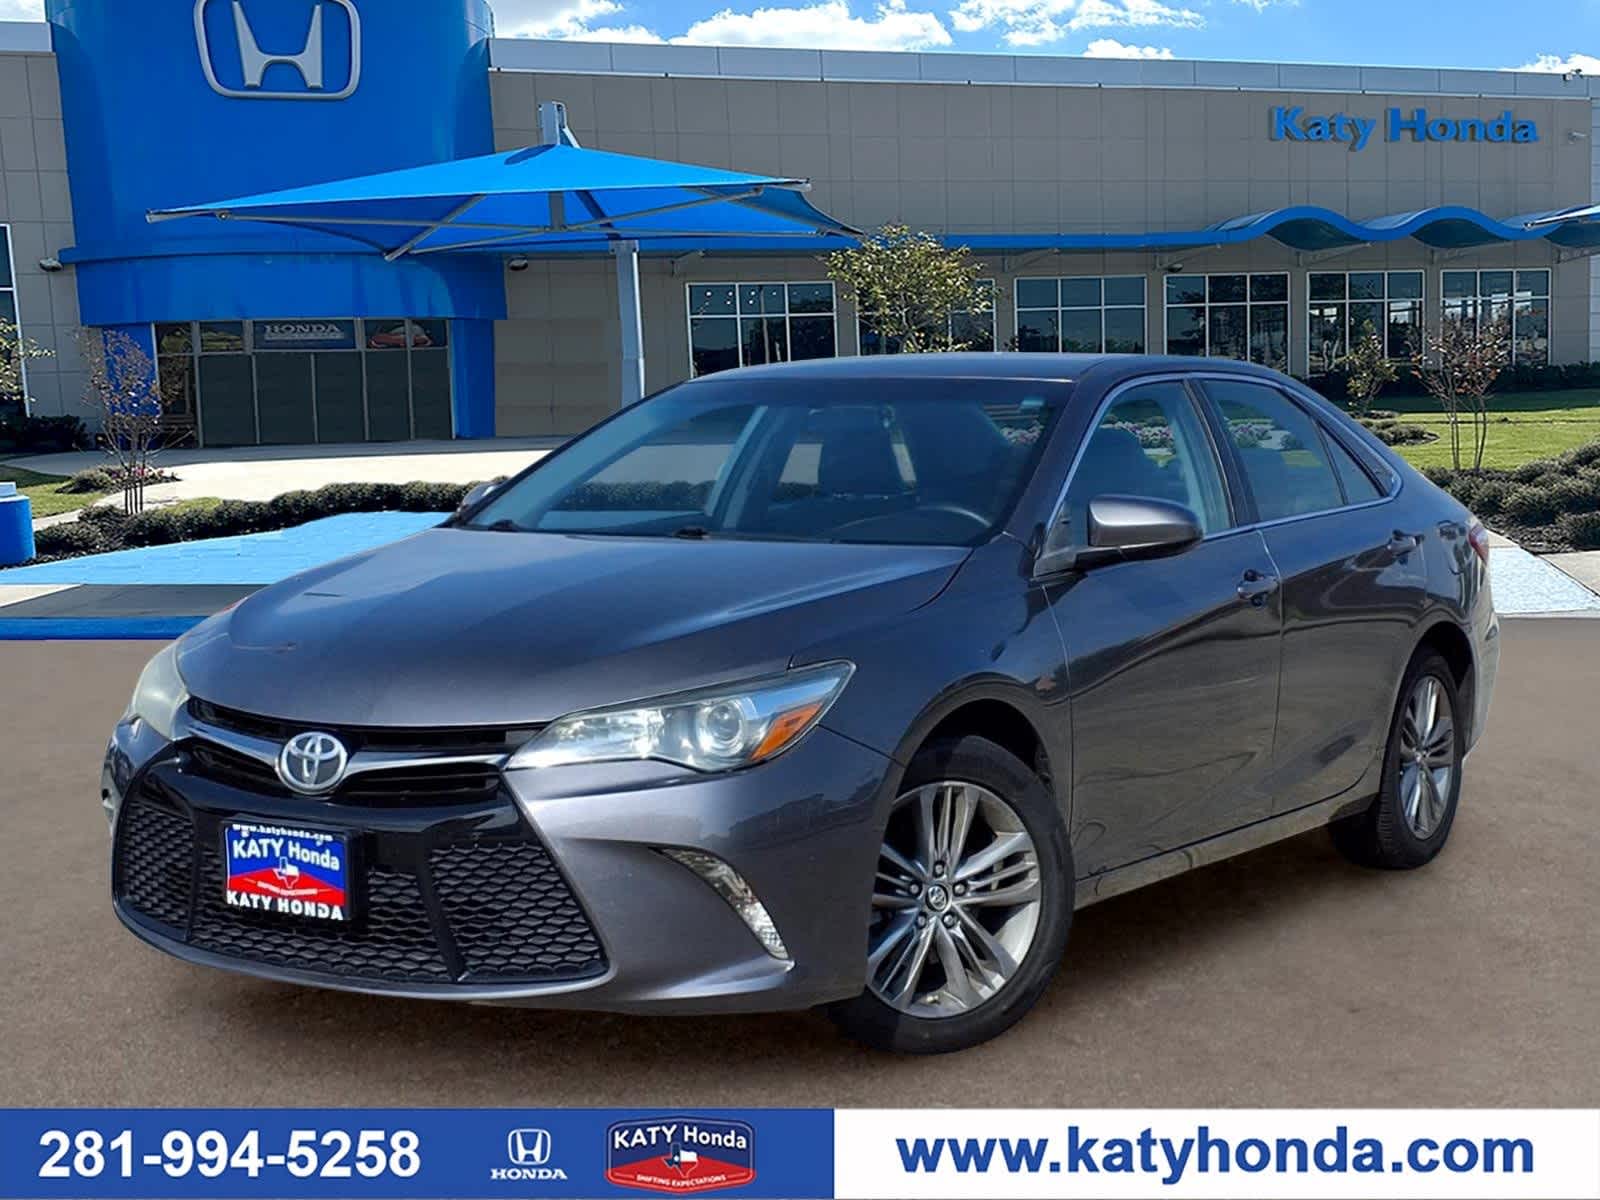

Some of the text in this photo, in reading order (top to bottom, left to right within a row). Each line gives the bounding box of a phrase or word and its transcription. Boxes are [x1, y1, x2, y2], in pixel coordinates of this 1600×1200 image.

[1270, 106, 1540, 151] Katy Honda
[232, 838, 340, 871] KATY Honda
[226, 890, 344, 921] KATY HONDA
